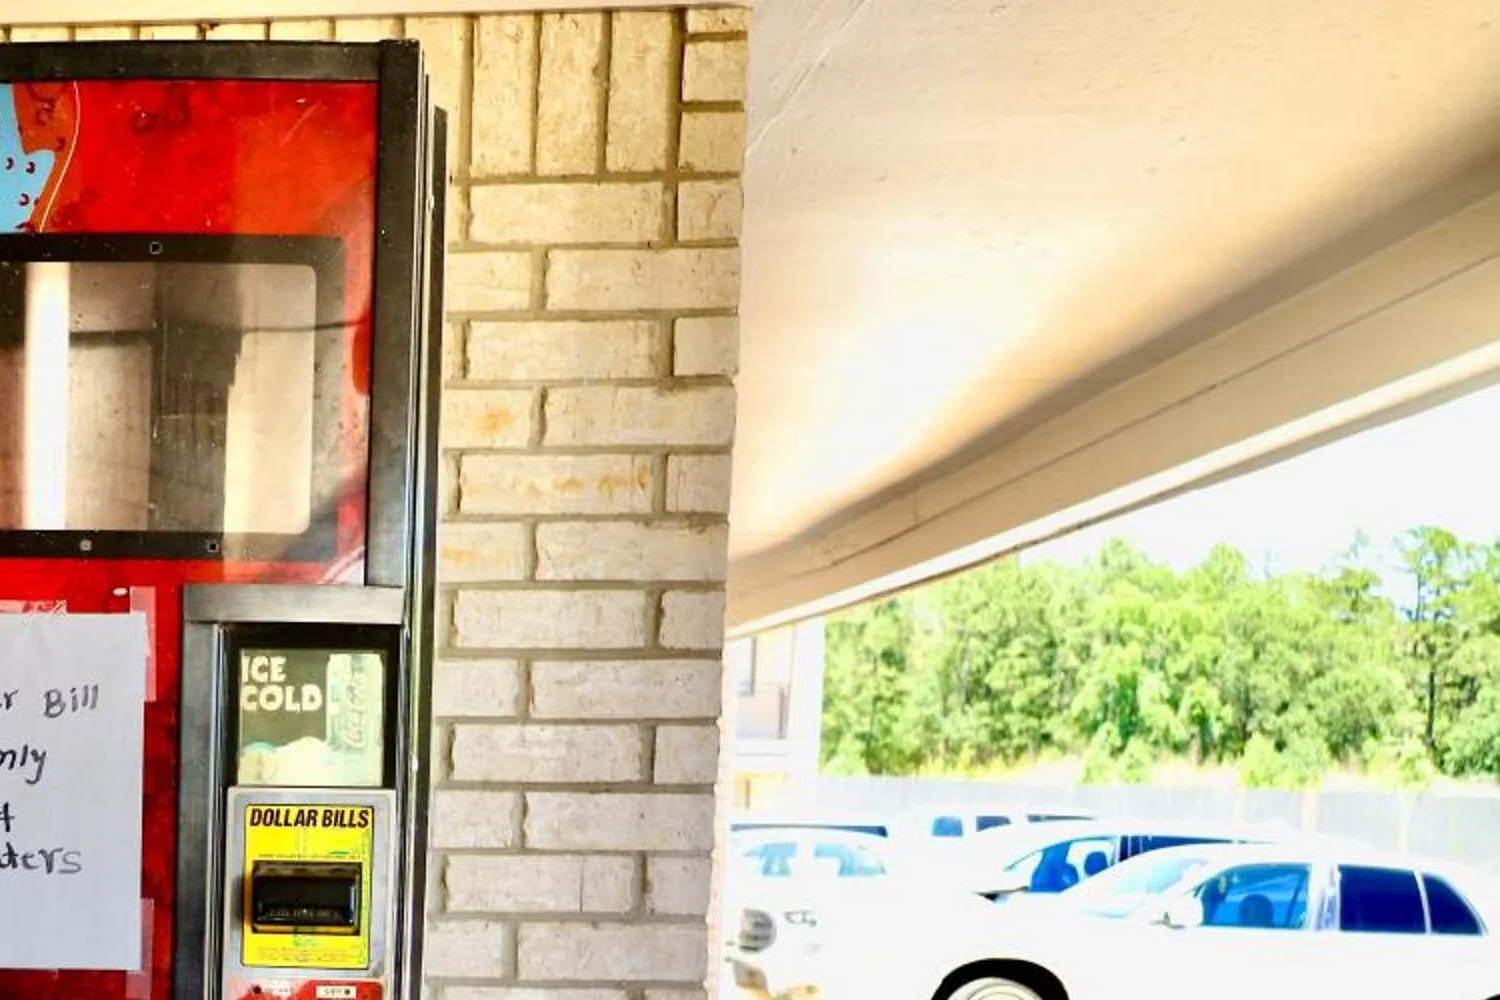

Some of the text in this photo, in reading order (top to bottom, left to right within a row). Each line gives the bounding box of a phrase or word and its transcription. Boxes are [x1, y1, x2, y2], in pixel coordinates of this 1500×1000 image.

[242, 655, 287, 682] ICE
[43, 684, 100, 719] Bill
[242, 683, 323, 711] COLD
[249, 808, 370, 828] DOLLAR BILLS
